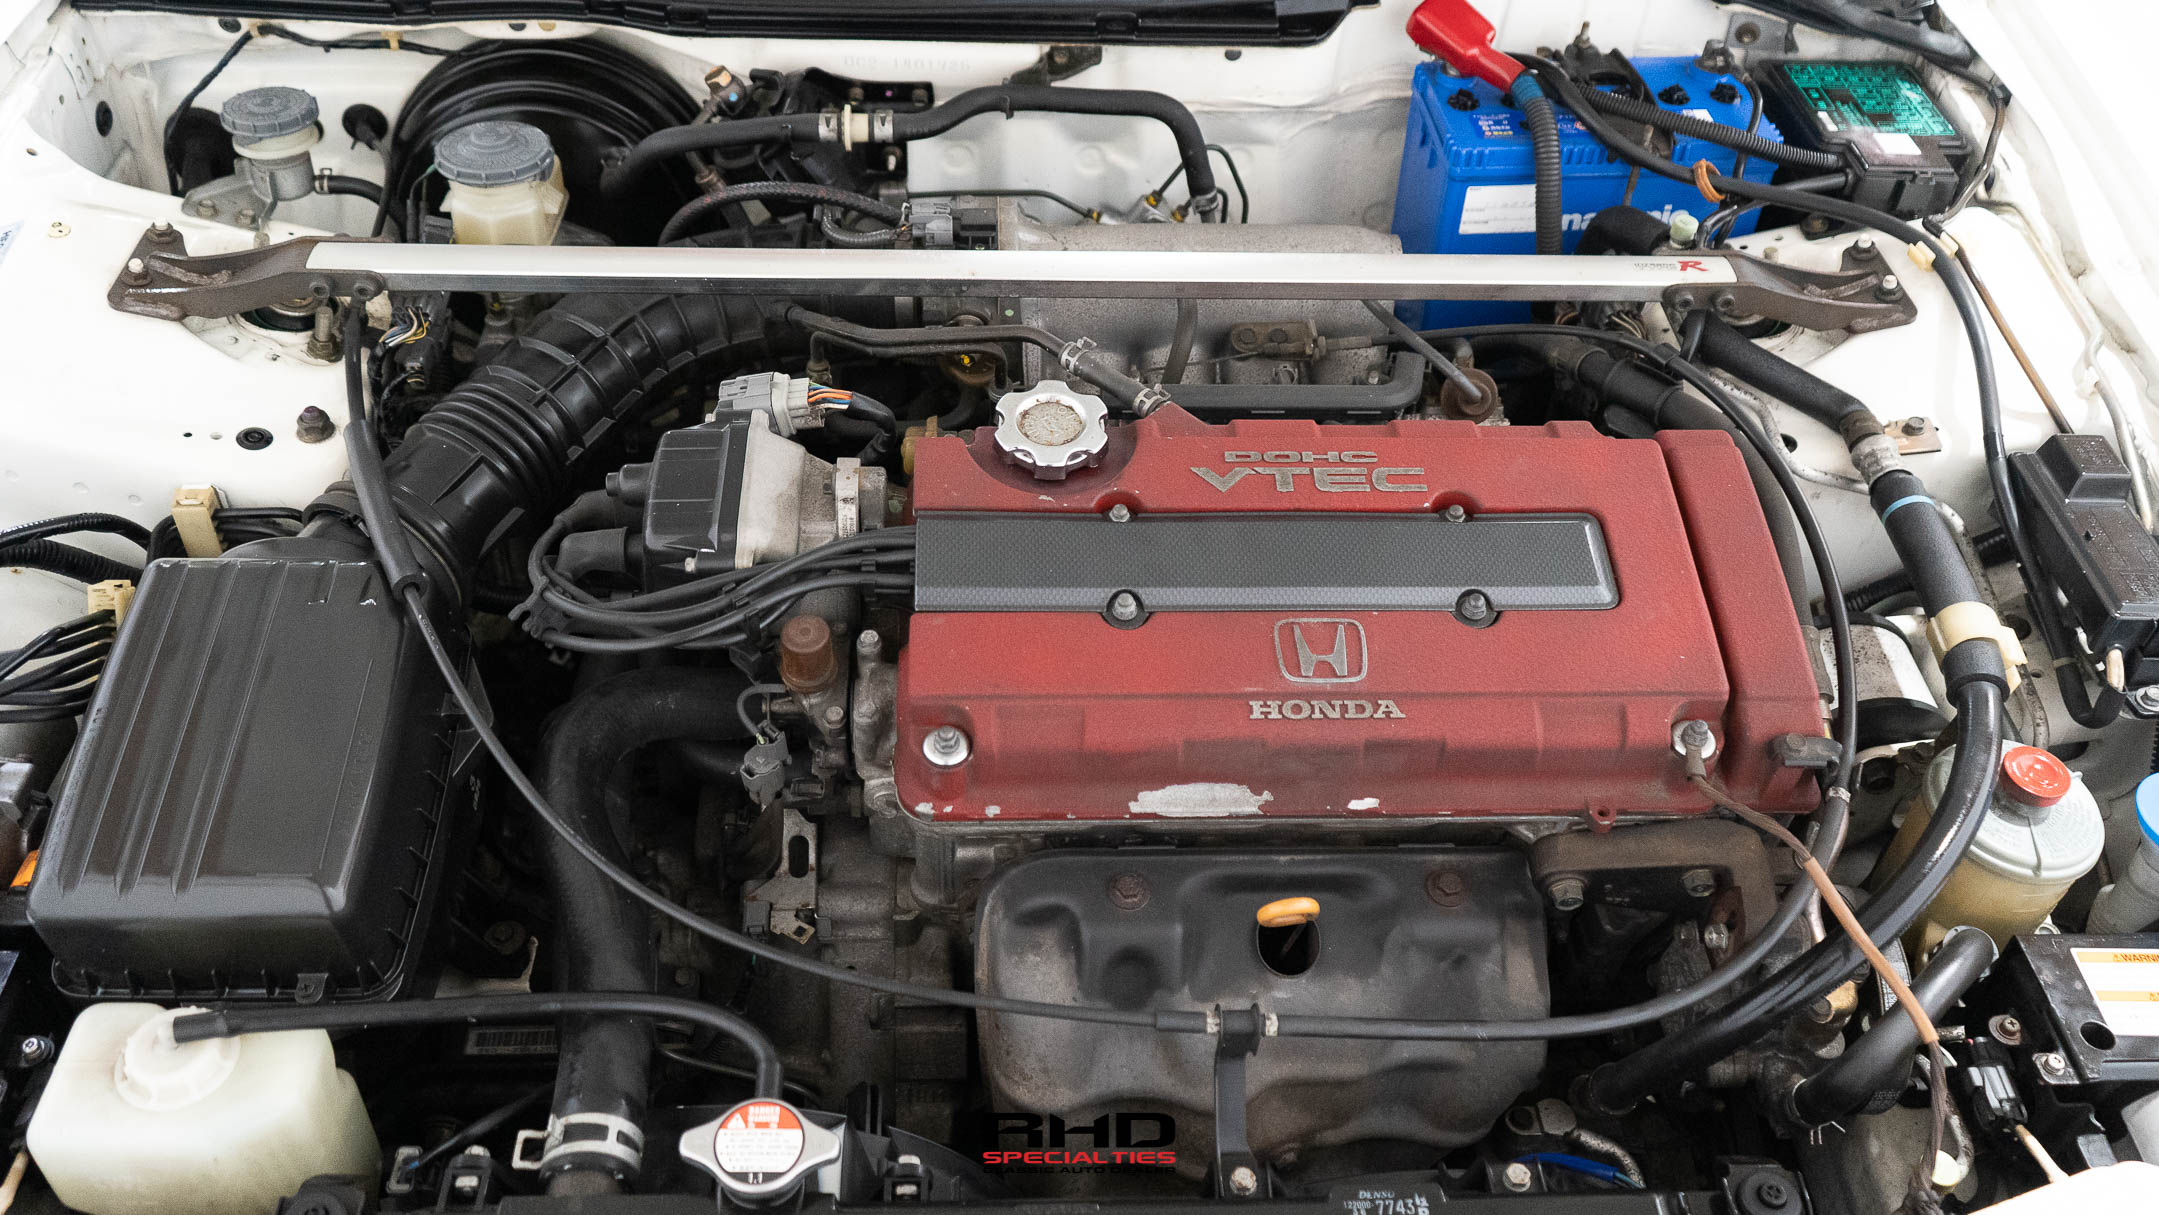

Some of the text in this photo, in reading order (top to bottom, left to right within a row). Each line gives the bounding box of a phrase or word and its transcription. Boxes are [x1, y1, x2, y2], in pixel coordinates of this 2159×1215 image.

[1223, 451, 1378, 463] DOHC
[1190, 466, 1428, 494] VTEC
[1249, 699, 1407, 720] HONDA
[1358, 1190, 1396, 1199] DENSO
